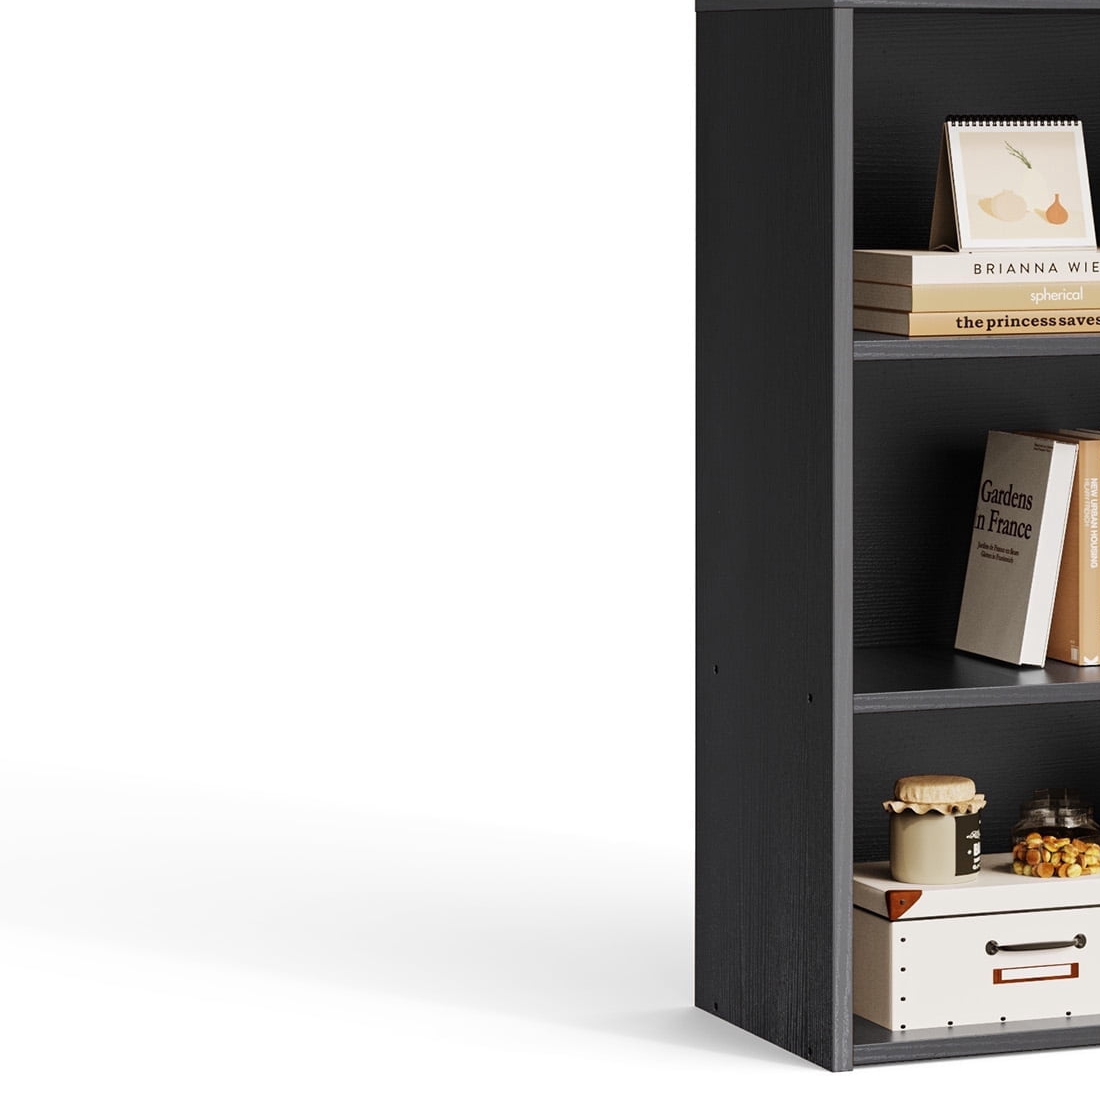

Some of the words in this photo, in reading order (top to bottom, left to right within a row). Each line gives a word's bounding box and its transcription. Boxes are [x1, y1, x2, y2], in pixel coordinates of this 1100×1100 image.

[973, 261, 1058, 275] BRIANNA
[1030, 287, 1084, 304] spherical
[956, 315, 984, 329] the
[986, 313, 1057, 332] princess
[981, 479, 1033, 511] Gardens
[1090, 477, 1098, 498] NEW
[973, 513, 985, 530] n
[986, 509, 1032, 540] France
[1090, 499, 1098, 529] URBAN
[1090, 530, 1098, 568] HOUSING
